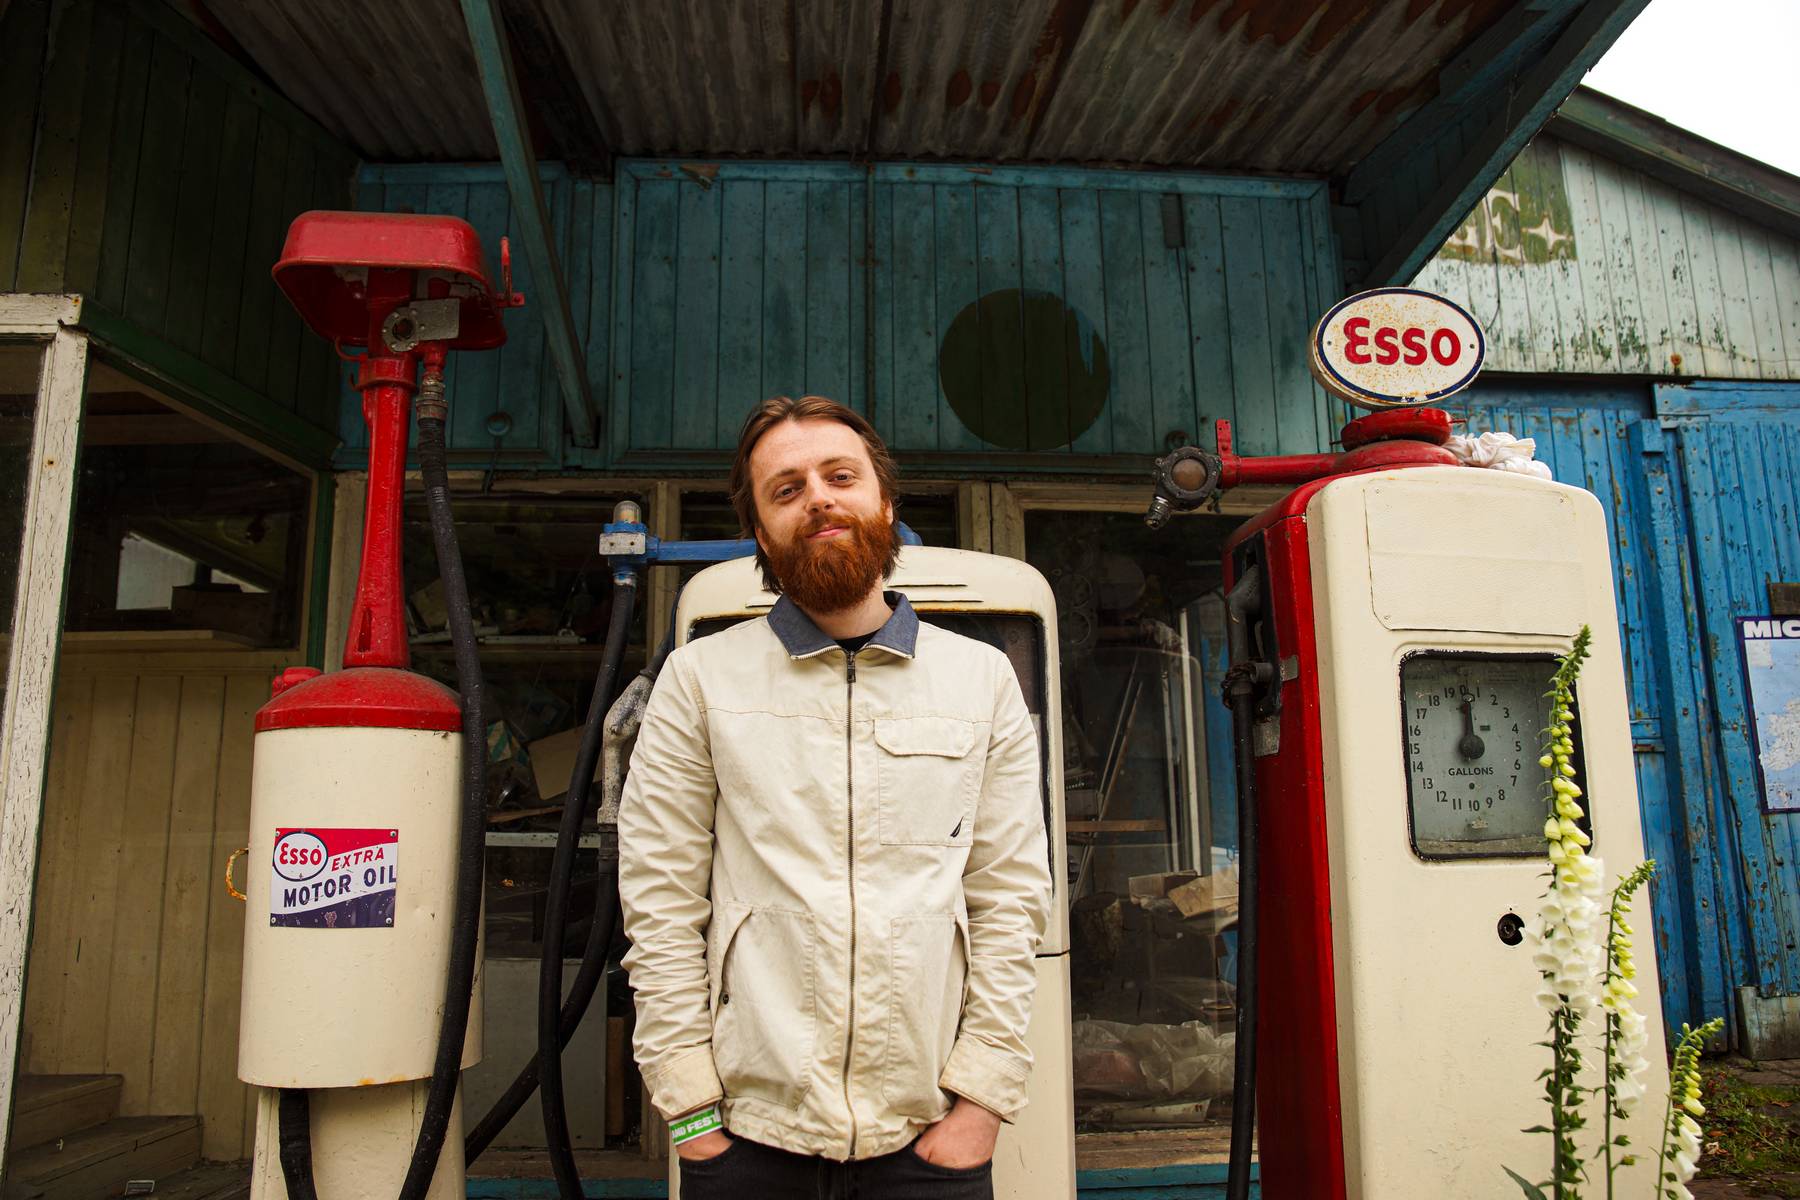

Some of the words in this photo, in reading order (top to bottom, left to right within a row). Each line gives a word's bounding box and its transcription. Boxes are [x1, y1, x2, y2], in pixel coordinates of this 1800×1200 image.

[1444, 687, 1455, 698] 19
[1428, 695, 1440, 707] 18
[1490, 695, 1498, 705] 2
[1416, 708, 1428, 720] 17
[1503, 707, 1510, 719] 3
[1409, 725, 1421, 737] 16
[1511, 723, 1519, 734] 4
[1409, 743, 1421, 755] 15
[1515, 741, 1522, 752] 5
[1412, 761, 1424, 773] 14
[1514, 759, 1521, 770] 6
[1448, 767, 1494, 776] GALLONS
[1422, 778, 1433, 790] 13
[1510, 775, 1518, 787] 7
[1436, 790, 1448, 802] 12
[1498, 789, 1505, 801] 8
[1452, 798, 1462, 810] 11
[1468, 800, 1480, 811] 10
[1486, 797, 1493, 809] 9
[331, 847, 384, 872] EXTRA
[284, 874, 352, 908] MOTOR
[363, 865, 397, 887] OIL
